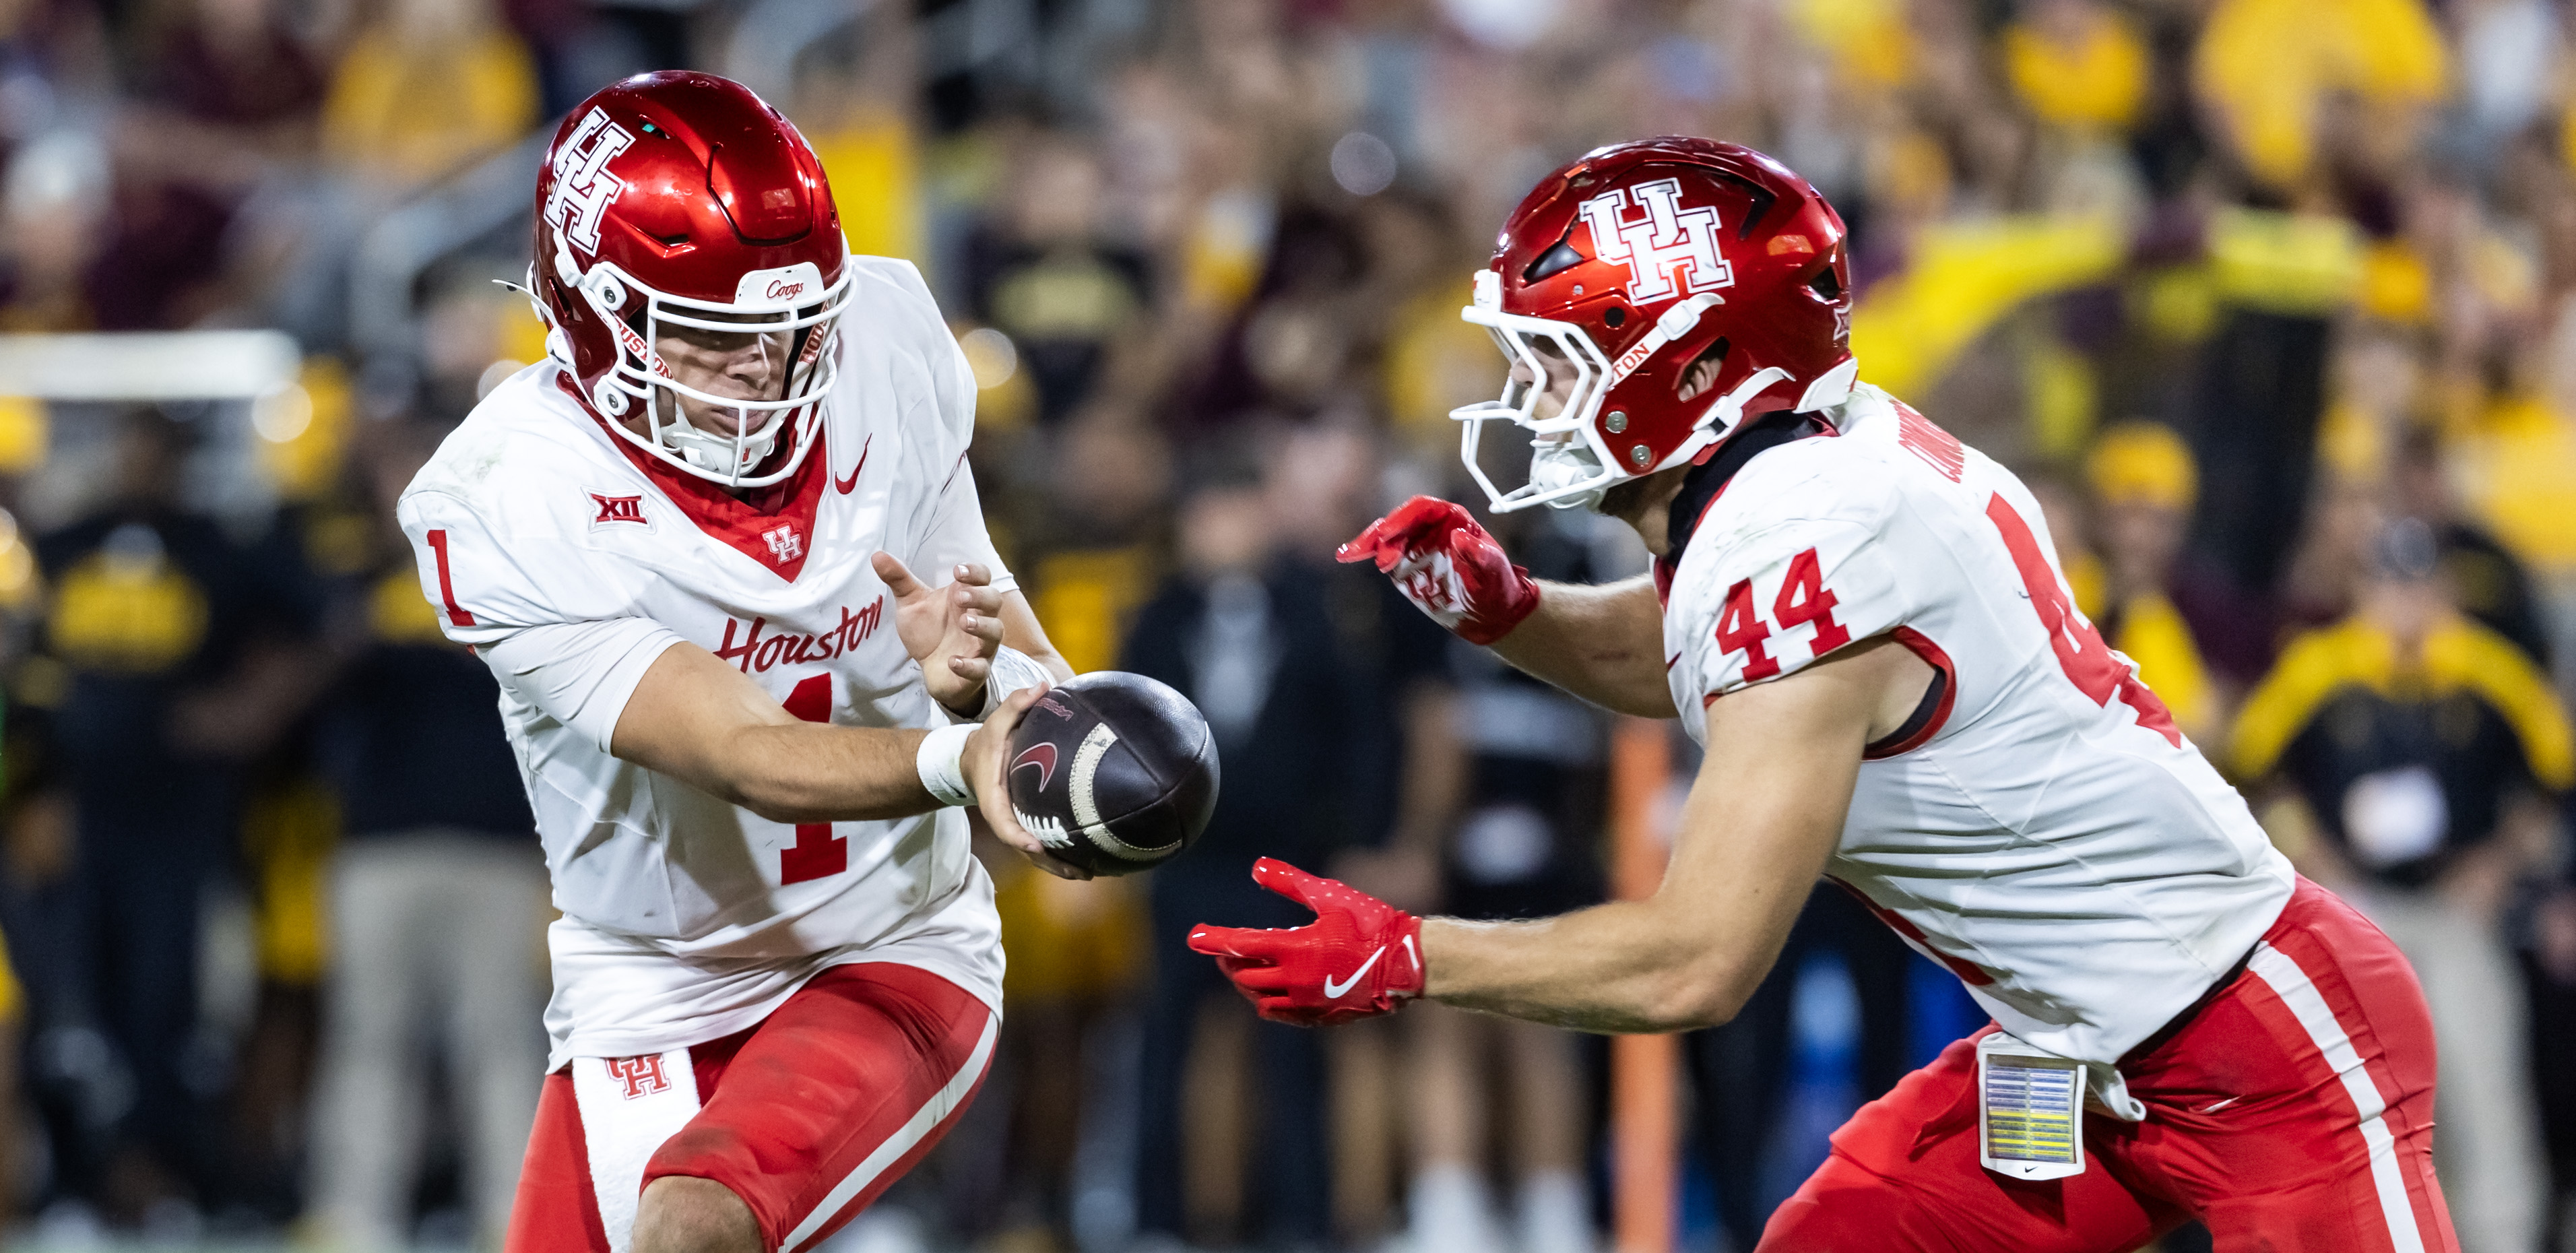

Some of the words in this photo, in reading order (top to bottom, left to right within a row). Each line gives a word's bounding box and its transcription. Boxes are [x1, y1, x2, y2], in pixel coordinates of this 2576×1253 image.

[1578, 177, 1735, 307] UH
[767, 280, 804, 300] Coogs
[590, 492, 648, 525] XII
[762, 525, 803, 564] UH
[426, 529, 477, 626] 1
[1715, 546, 1852, 684] 44
[713, 593, 883, 674] Houston
